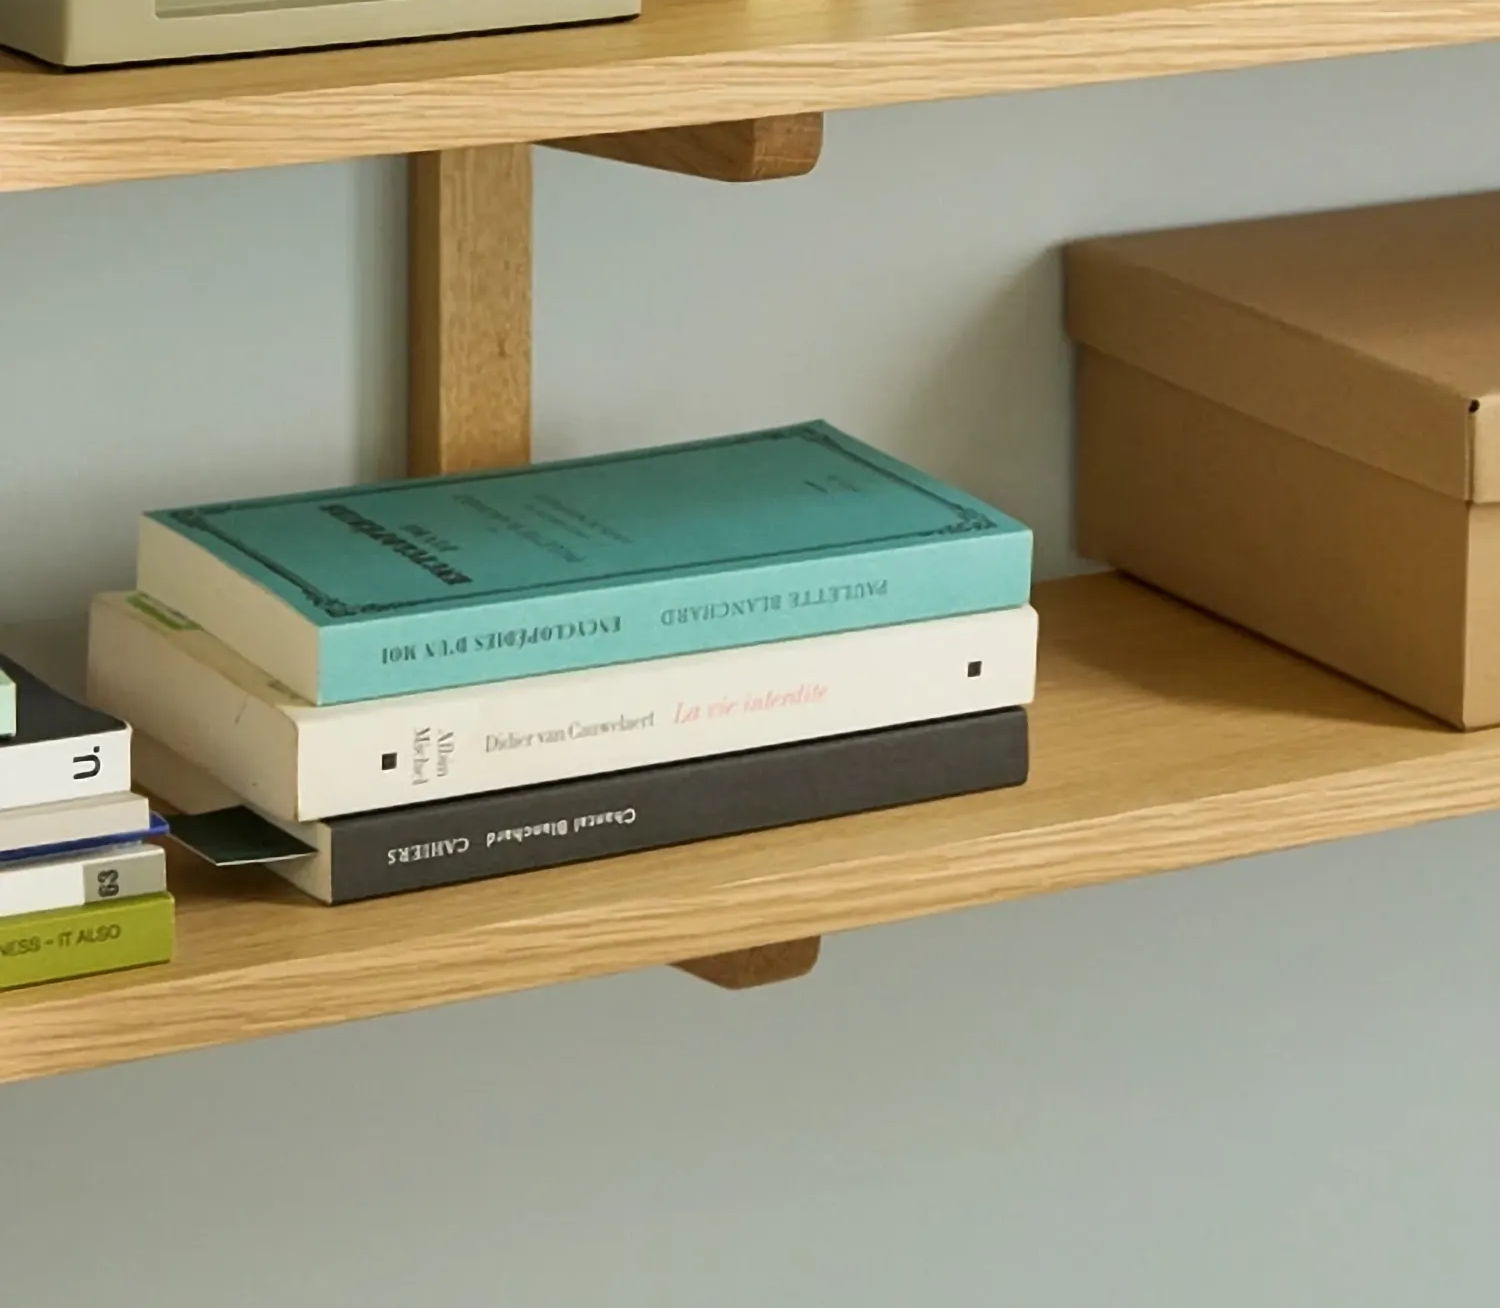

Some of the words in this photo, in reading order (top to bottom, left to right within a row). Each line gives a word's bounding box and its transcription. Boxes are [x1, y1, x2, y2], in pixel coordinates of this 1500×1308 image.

[789, 579, 889, 609] PAULETTE
[661, 594, 782, 627] BLANCHARD
[475, 615, 622, 651] ENCYCLOPÉDIES
[381, 646, 417, 665] MOI
[671, 700, 702, 726] La
[706, 696, 738, 720] vie
[743, 683, 828, 713] interdite
[485, 733, 533, 753] Didier
[537, 728, 566, 745] van
[568, 711, 655, 740] Cauwelaert
[486, 818, 569, 848] Blanchard
[573, 807, 637, 833] Chantal
[387, 837, 470, 866] CAHIERS
[58, 929, 72, 948] IT
[76, 923, 121, 945] ALSO
